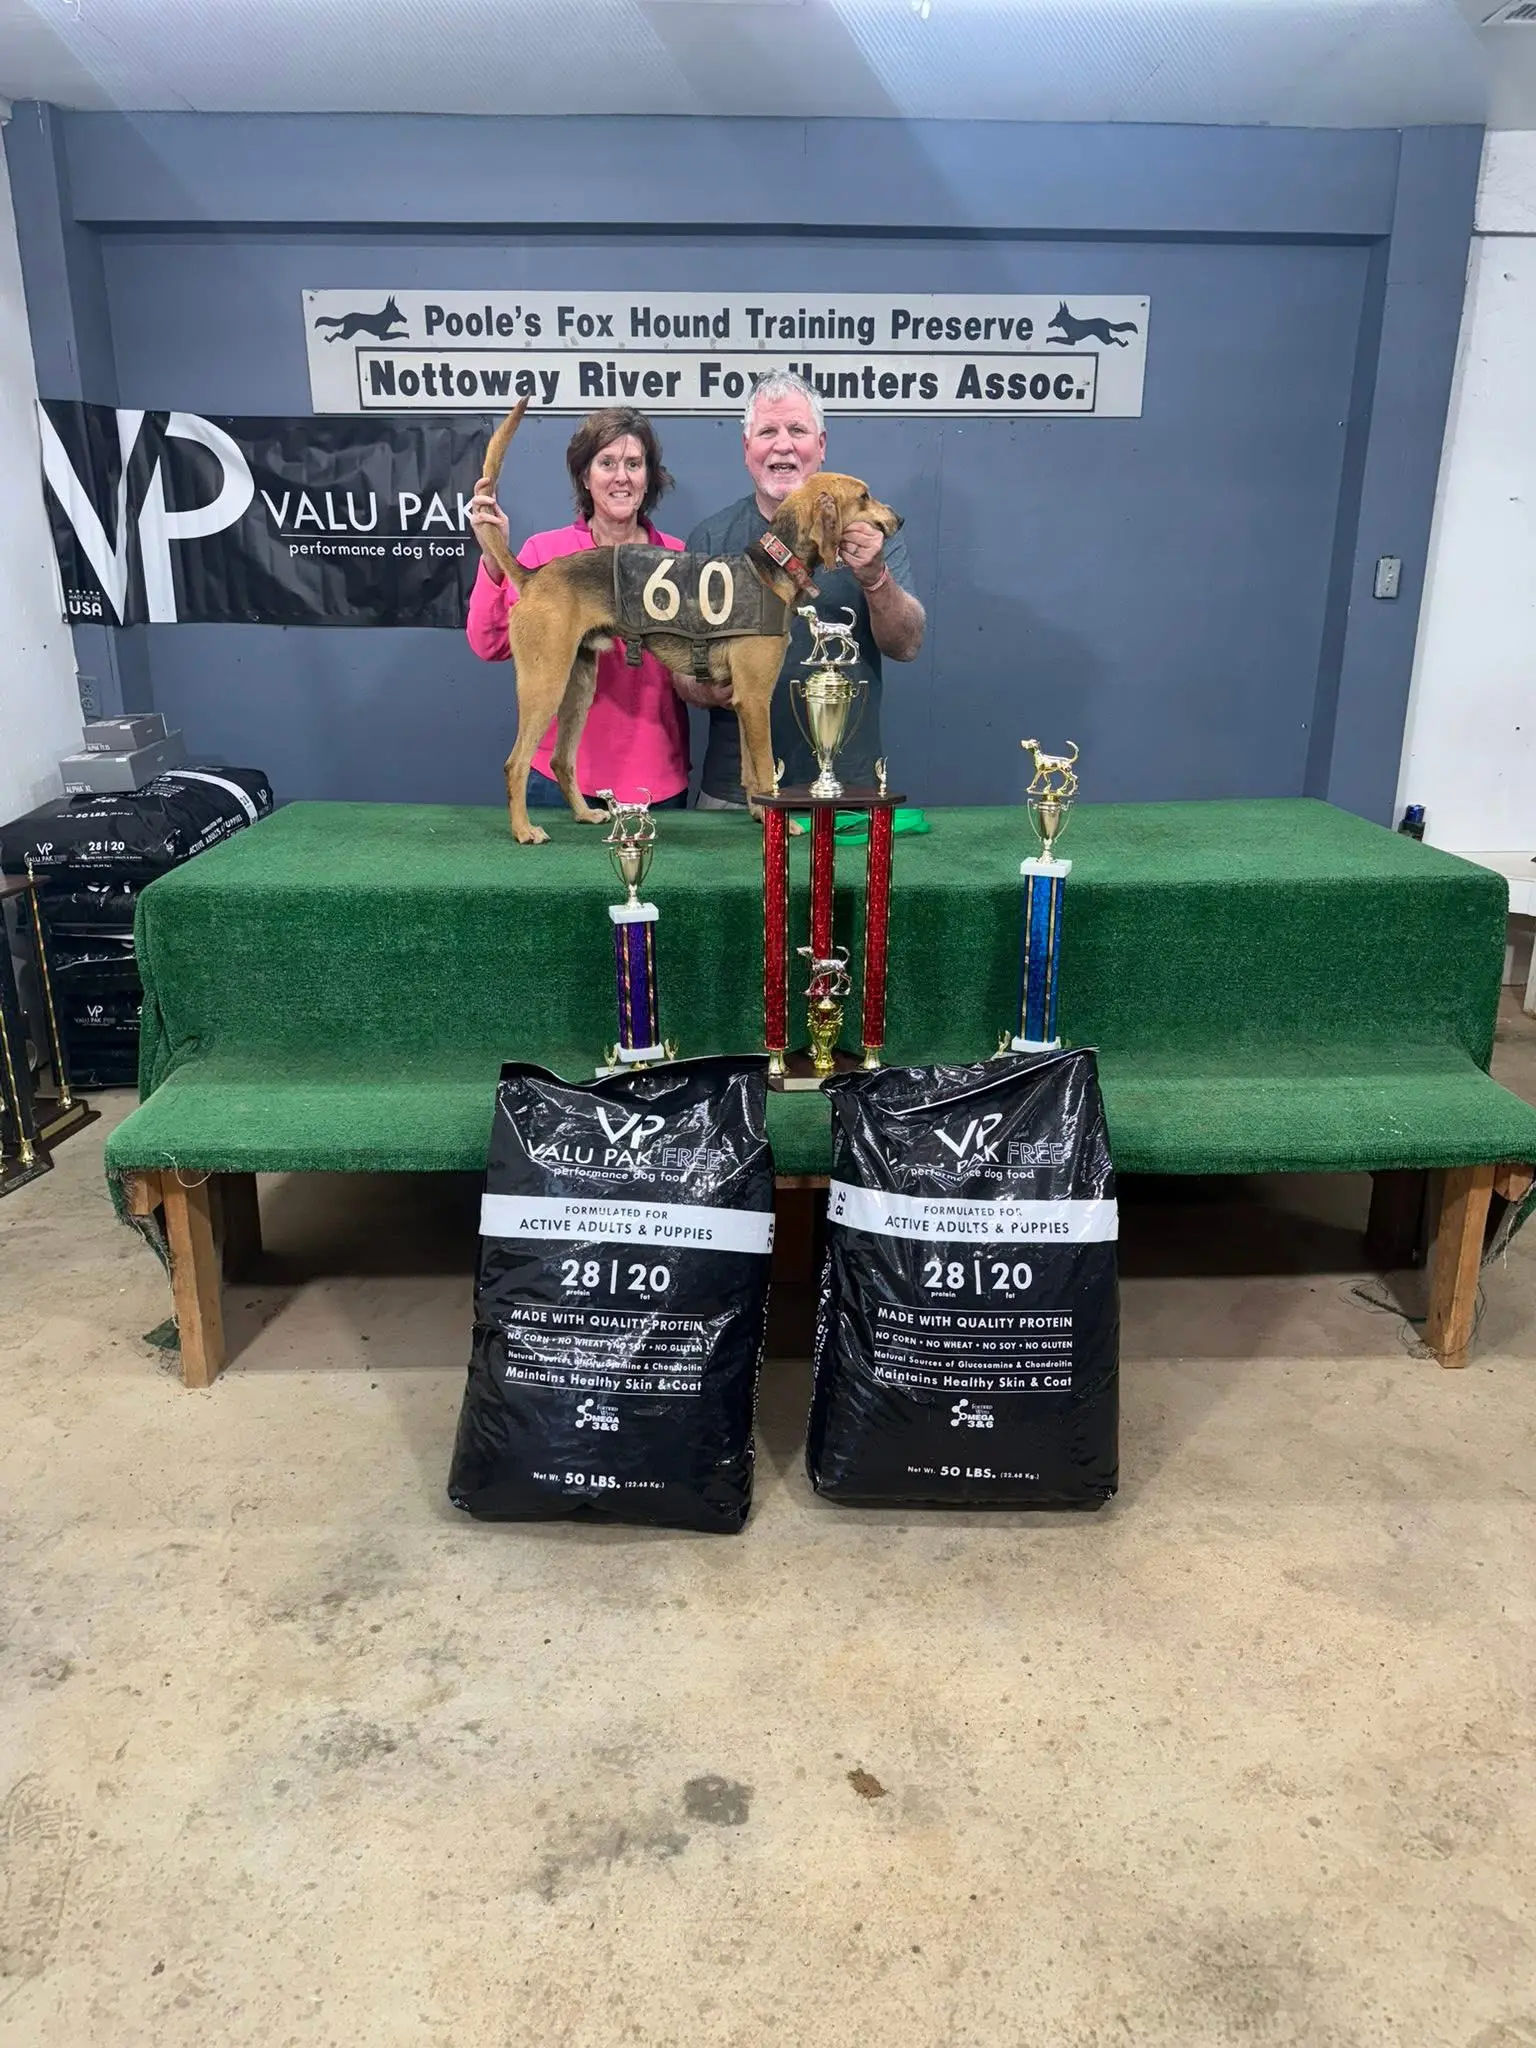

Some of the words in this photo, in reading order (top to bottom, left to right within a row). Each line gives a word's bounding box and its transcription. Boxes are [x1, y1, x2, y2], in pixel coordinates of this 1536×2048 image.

[424, 304, 542, 337] Poole's
[557, 306, 615, 338] Fox
[630, 307, 729, 339] Hound
[745, 308, 875, 345] Training
[891, 309, 1034, 341] Preserve
[369, 360, 560, 404] Nottoway
[579, 361, 681, 398] River
[956, 364, 1085, 400] Assoc.
[260, 489, 377, 532] VALU
[400, 491, 477, 532] PAK
[289, 541, 386, 558] performance
[392, 541, 423, 560] dog
[429, 542, 465, 558] food
[643, 558, 734, 625] 60
[69, 600, 102, 616] USA
[88, 841, 101, 851] 28
[111, 841, 125, 851] 20
[526, 1139, 593, 1165] VALU
[604, 1148, 652, 1168] PAK
[661, 1147, 722, 1171] FREE
[1006, 1141, 1067, 1166] FREE
[553, 1166, 629, 1181] performance
[633, 1170, 656, 1183] dog
[660, 1171, 687, 1183] food
[984, 1168, 1003, 1181] dog
[1007, 1168, 1035, 1180] food
[565, 1205, 641, 1219] FORMULATED
[646, 1209, 668, 1220] FOR
[924, 1205, 994, 1217] FORMULATED
[519, 1218, 571, 1232] ACTIVE
[577, 1221, 632, 1235] ADULTS
[638, 1224, 647, 1236] &
[654, 1225, 713, 1241] PUPPIES
[885, 1214, 929, 1232] ACTIVE
[935, 1220, 988, 1234] ADULTS
[995, 1223, 1005, 1234] &
[1011, 1222, 1069, 1235] PUPPIES
[560, 1258, 601, 1288] 28
[627, 1263, 671, 1293] 20
[923, 1260, 965, 1290] 28
[990, 1261, 1033, 1290] 20
[565, 1288, 591, 1297] protein
[639, 1293, 651, 1301] fat
[930, 1290, 956, 1299] protein
[1005, 1291, 1015, 1299] fat
[511, 1310, 547, 1323] MADE
[552, 1312, 585, 1325] WITH
[589, 1315, 648, 1330] QUALITY
[651, 1319, 703, 1332] PROTEIN
[878, 1307, 914, 1325] MADE
[919, 1314, 951, 1328] WITH
[957, 1317, 1014, 1330] QUALITY
[1019, 1316, 1073, 1329] PROTEIN
[507, 1332, 521, 1341] NO
[523, 1333, 549, 1345] CORN
[558, 1336, 572, 1346] NO
[655, 1343, 668, 1352] NO
[670, 1343, 703, 1353] GLUTEN
[875, 1331, 890, 1341] NO
[892, 1333, 917, 1345] CORN
[926, 1339, 941, 1349] NO
[943, 1340, 973, 1350] WHEAT
[982, 1341, 997, 1350] NO
[999, 1341, 1017, 1351] SOY
[1025, 1340, 1039, 1350] NO
[1041, 1340, 1073, 1350] GLUTEN
[507, 1351, 536, 1361] Natural
[643, 1362, 650, 1371] &
[874, 1350, 906, 1363] Natural
[908, 1355, 942, 1368] Sources
[945, 1359, 955, 1368] of
[958, 1360, 1013, 1369] Glucosamine
[1016, 1360, 1022, 1369] &
[1025, 1359, 1073, 1369] Chondroitin
[505, 1366, 565, 1384] Maintains
[570, 1373, 620, 1391] Healthy
[625, 1378, 652, 1391] Skin
[657, 1380, 667, 1390] &
[671, 1380, 702, 1392] Coat
[874, 1365, 938, 1386] Maintains
[943, 1375, 994, 1390] Healthy
[999, 1376, 1025, 1388] Skin
[1030, 1377, 1039, 1388] &
[1043, 1375, 1072, 1388] Coat
[533, 1471, 547, 1480] Net
[564, 1472, 586, 1486] 50
[590, 1474, 621, 1490] LBS.
[907, 1466, 921, 1474] Net
[940, 1465, 960, 1477] 50
[965, 1466, 997, 1479] LBS.
